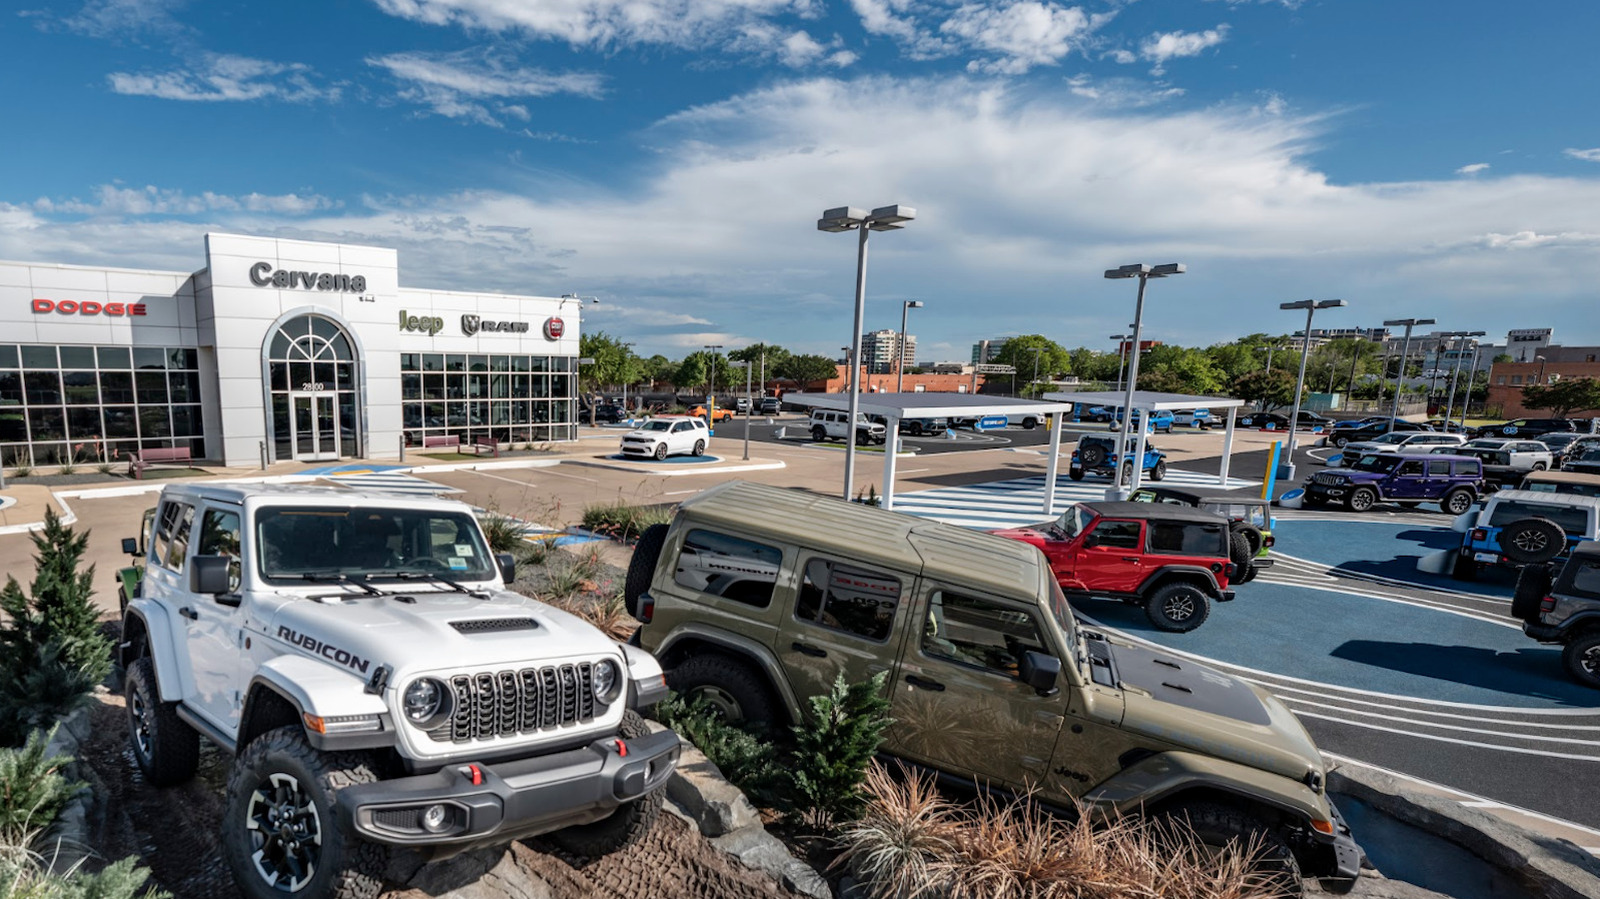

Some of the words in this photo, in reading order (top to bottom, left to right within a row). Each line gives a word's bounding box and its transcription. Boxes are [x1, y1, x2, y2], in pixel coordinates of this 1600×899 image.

[249, 261, 367, 292] Carvana
[31, 298, 147, 317] DODGE
[399, 310, 444, 336] Jeep
[481, 320, 529, 333] RAM
[277, 625, 370, 674] RUBICON
[1054, 766, 1090, 783] Jeep
